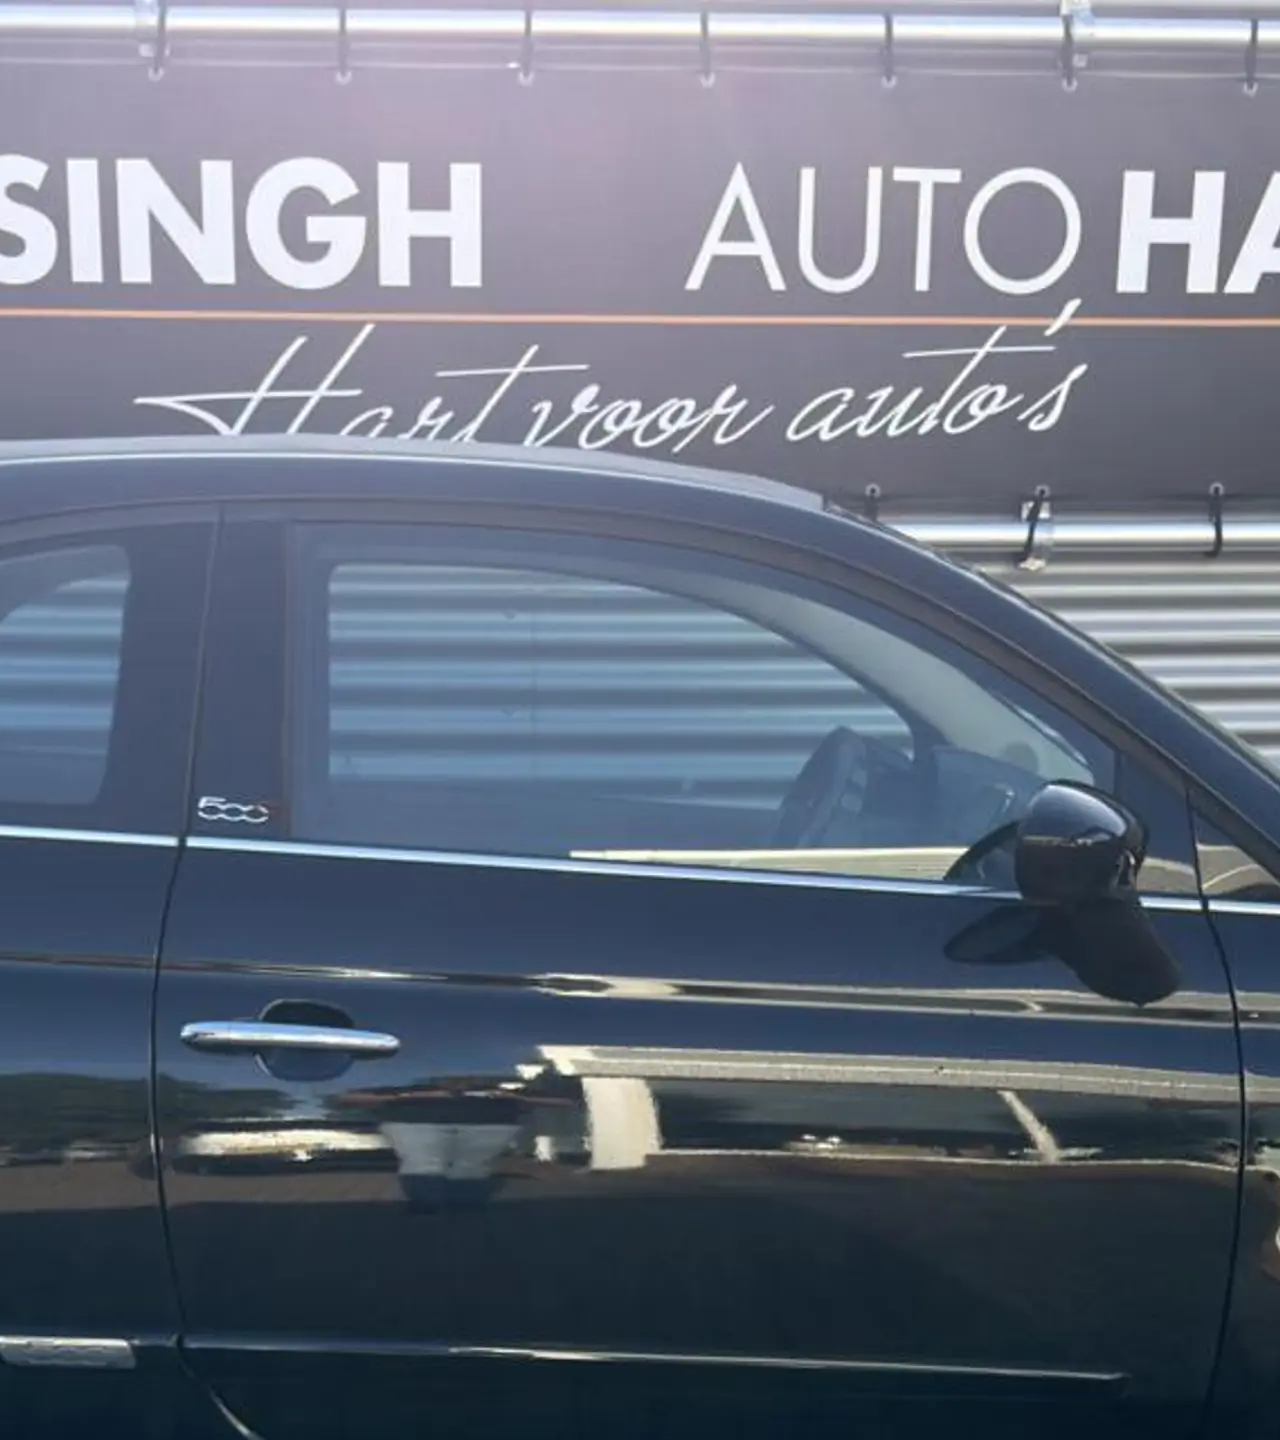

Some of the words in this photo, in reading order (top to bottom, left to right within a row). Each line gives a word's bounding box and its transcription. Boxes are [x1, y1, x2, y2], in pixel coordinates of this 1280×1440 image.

[684, 161, 1082, 296] AUTO
[523, 383, 773, 453] voor
[784, 299, 1089, 442] auto's
[197, 796, 269, 823] 500
